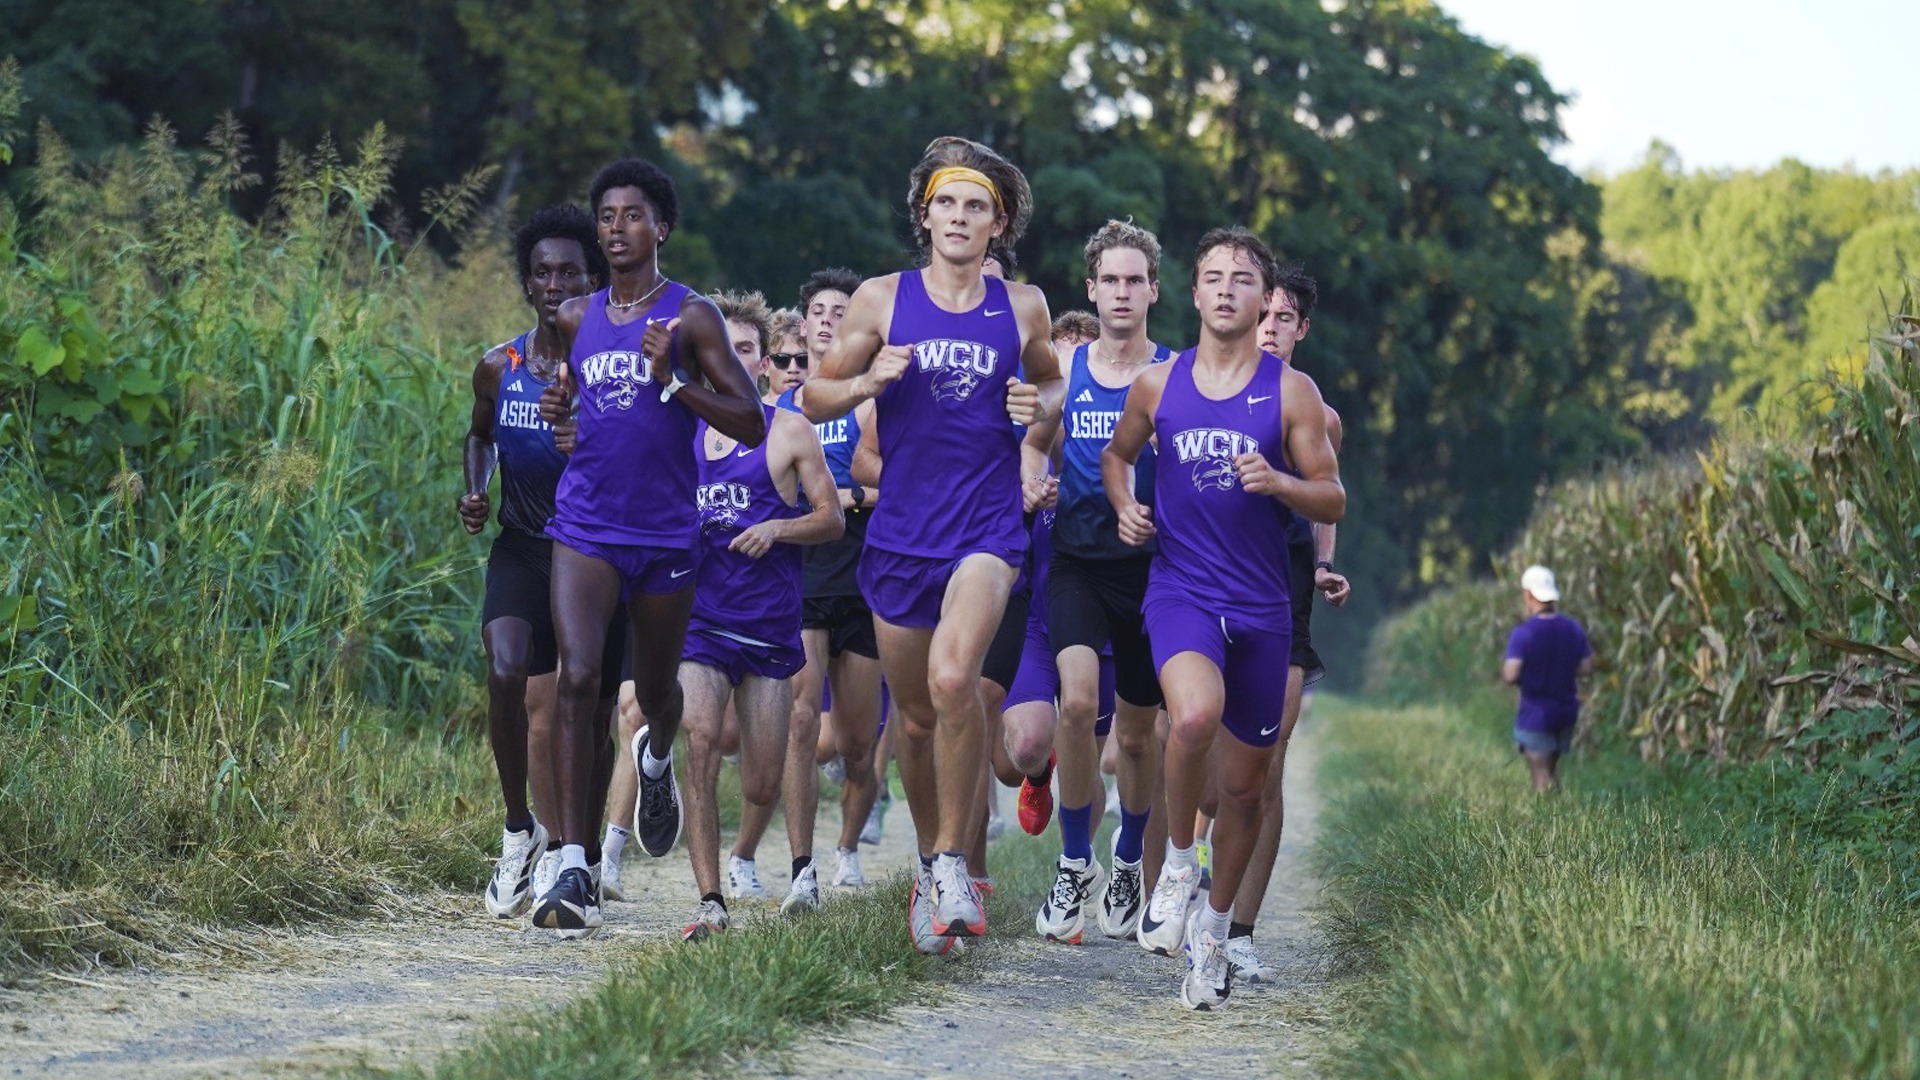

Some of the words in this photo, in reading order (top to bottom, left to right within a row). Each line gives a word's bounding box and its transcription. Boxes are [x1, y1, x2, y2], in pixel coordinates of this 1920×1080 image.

[581, 351, 654, 388] WCU
[914, 339, 998, 378] WCU
[1172, 427, 1259, 464] WCU
